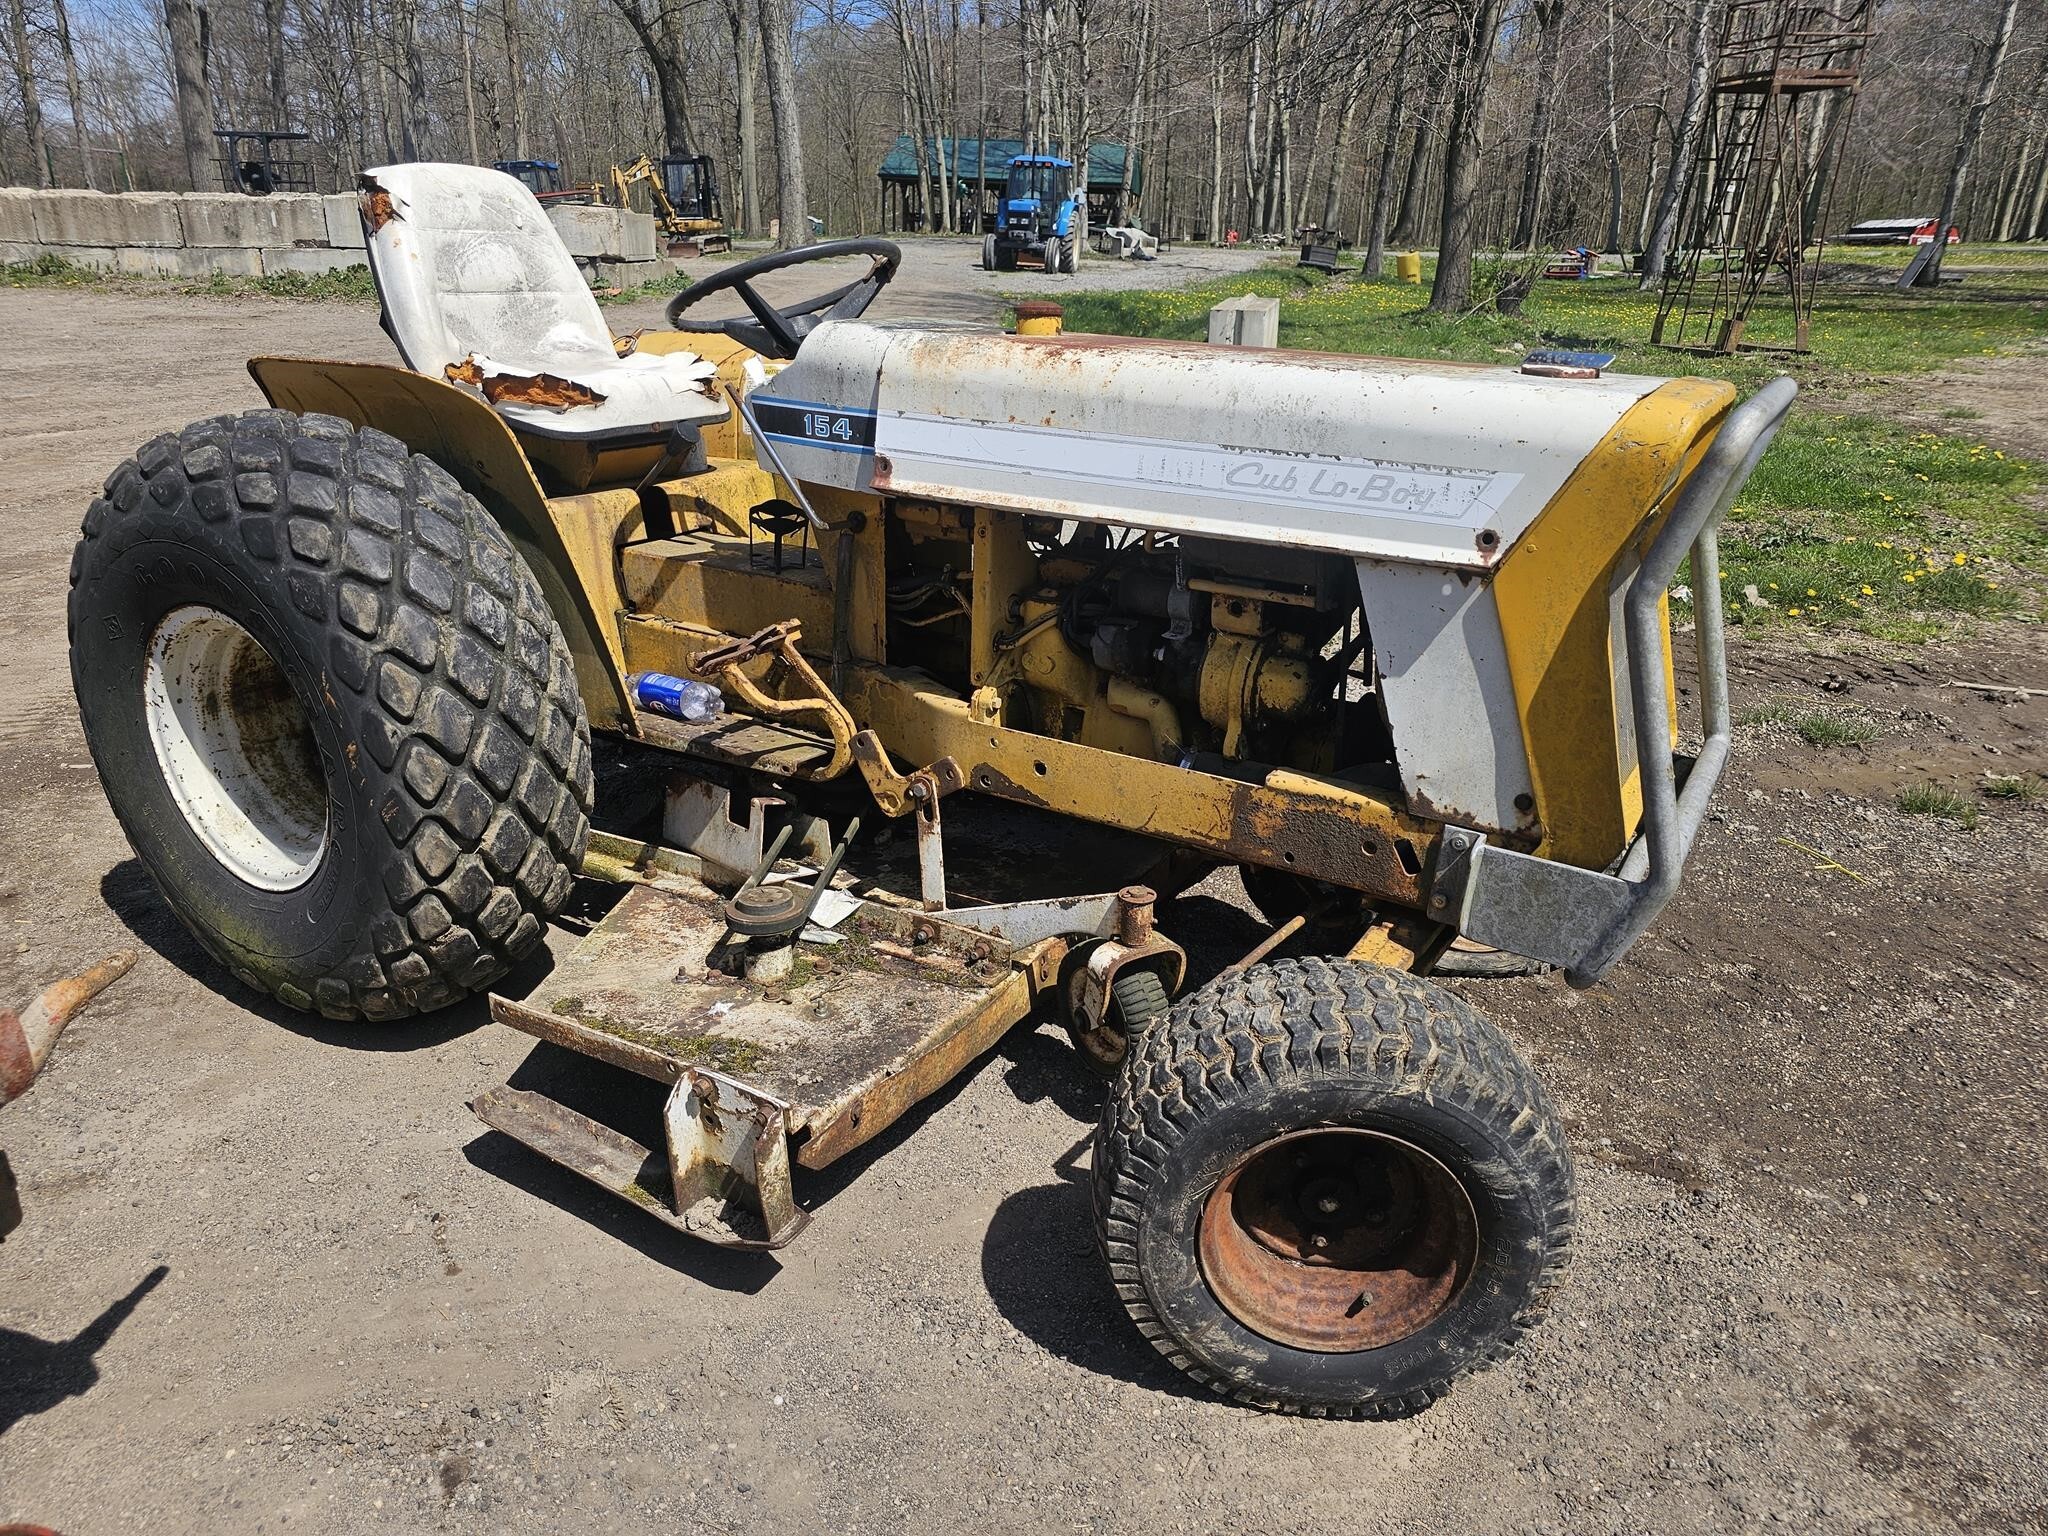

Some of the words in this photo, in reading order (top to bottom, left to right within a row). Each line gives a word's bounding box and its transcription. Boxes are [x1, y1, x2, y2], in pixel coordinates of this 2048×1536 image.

[803, 413, 853, 441] 154
[1225, 461, 1299, 493] Cub
[1308, 468, 1436, 513] Lo-Boy
[1382, 1343, 1435, 1379] NHS
